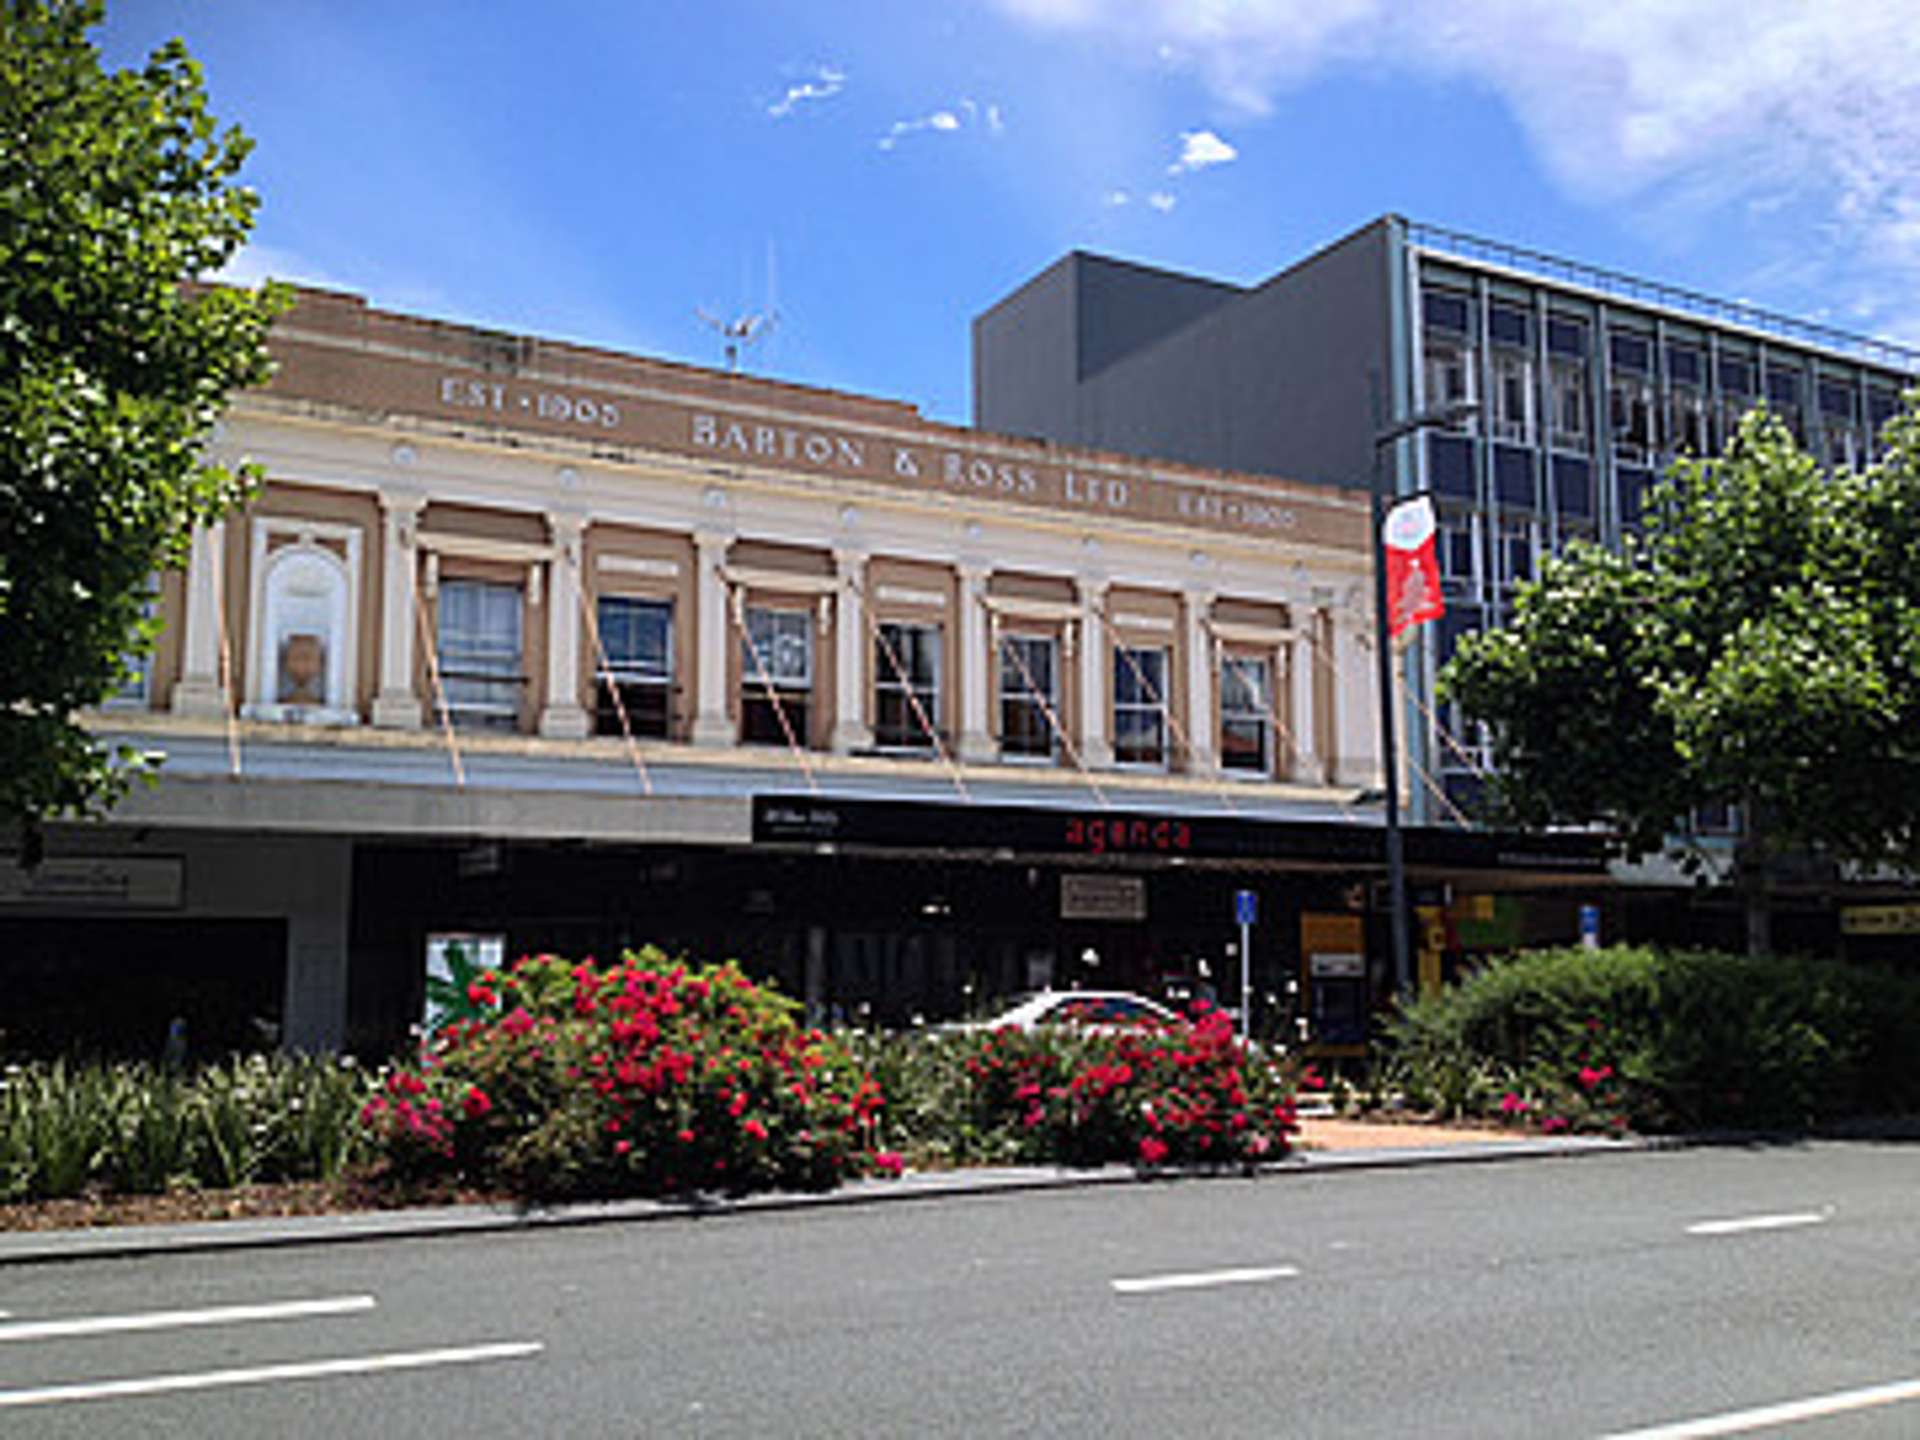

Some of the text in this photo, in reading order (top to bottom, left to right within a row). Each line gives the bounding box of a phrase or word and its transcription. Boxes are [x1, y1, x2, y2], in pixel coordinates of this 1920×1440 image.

[692, 413, 866, 468] BARTON
[895, 449, 919, 477] &
[944, 453, 1037, 494] ROSS
